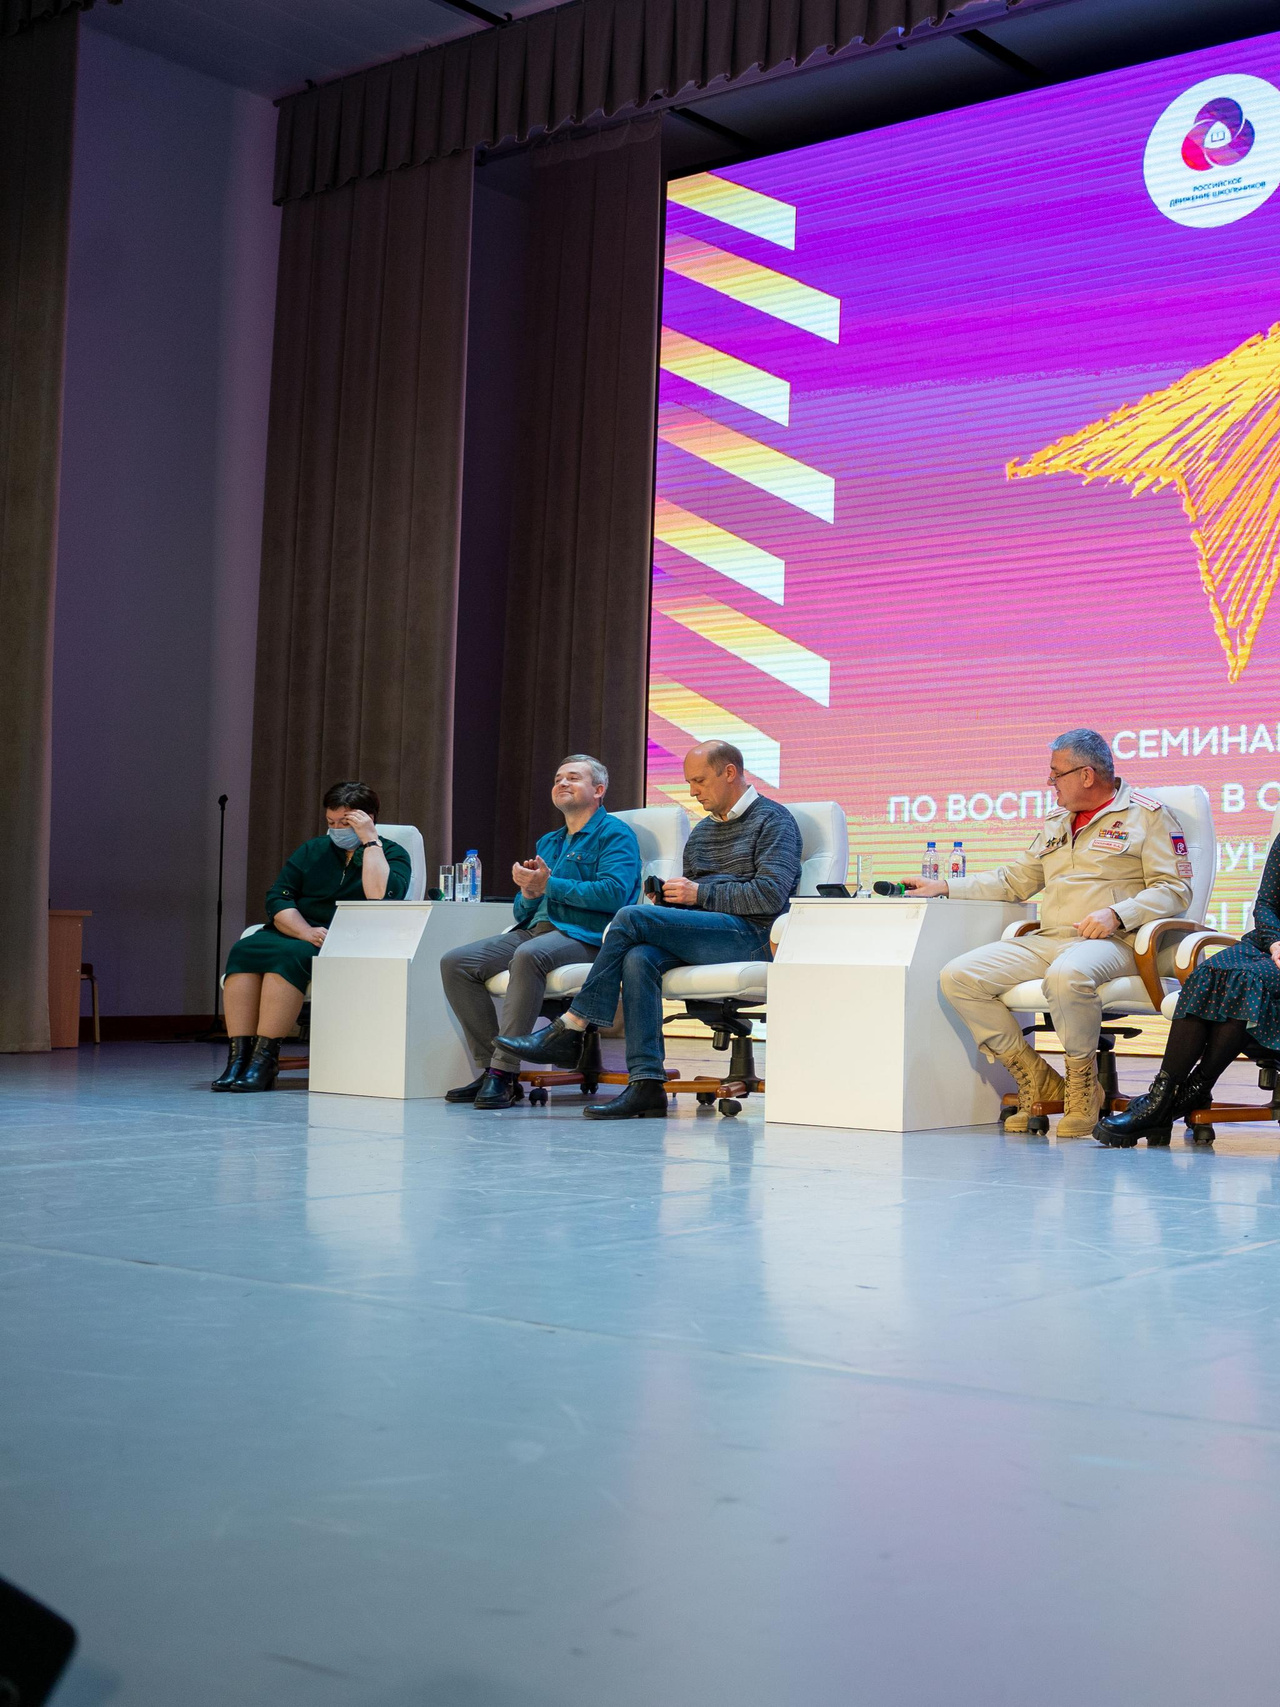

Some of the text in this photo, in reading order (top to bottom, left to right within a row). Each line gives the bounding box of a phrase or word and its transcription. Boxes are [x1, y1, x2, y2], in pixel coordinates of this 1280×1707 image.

[1169, 181, 1266, 207] ДВИЖЕНИЕ ШКОЛЬНИКОВ
[888, 794, 938, 823] ПО
[1221, 782, 1246, 813] В
